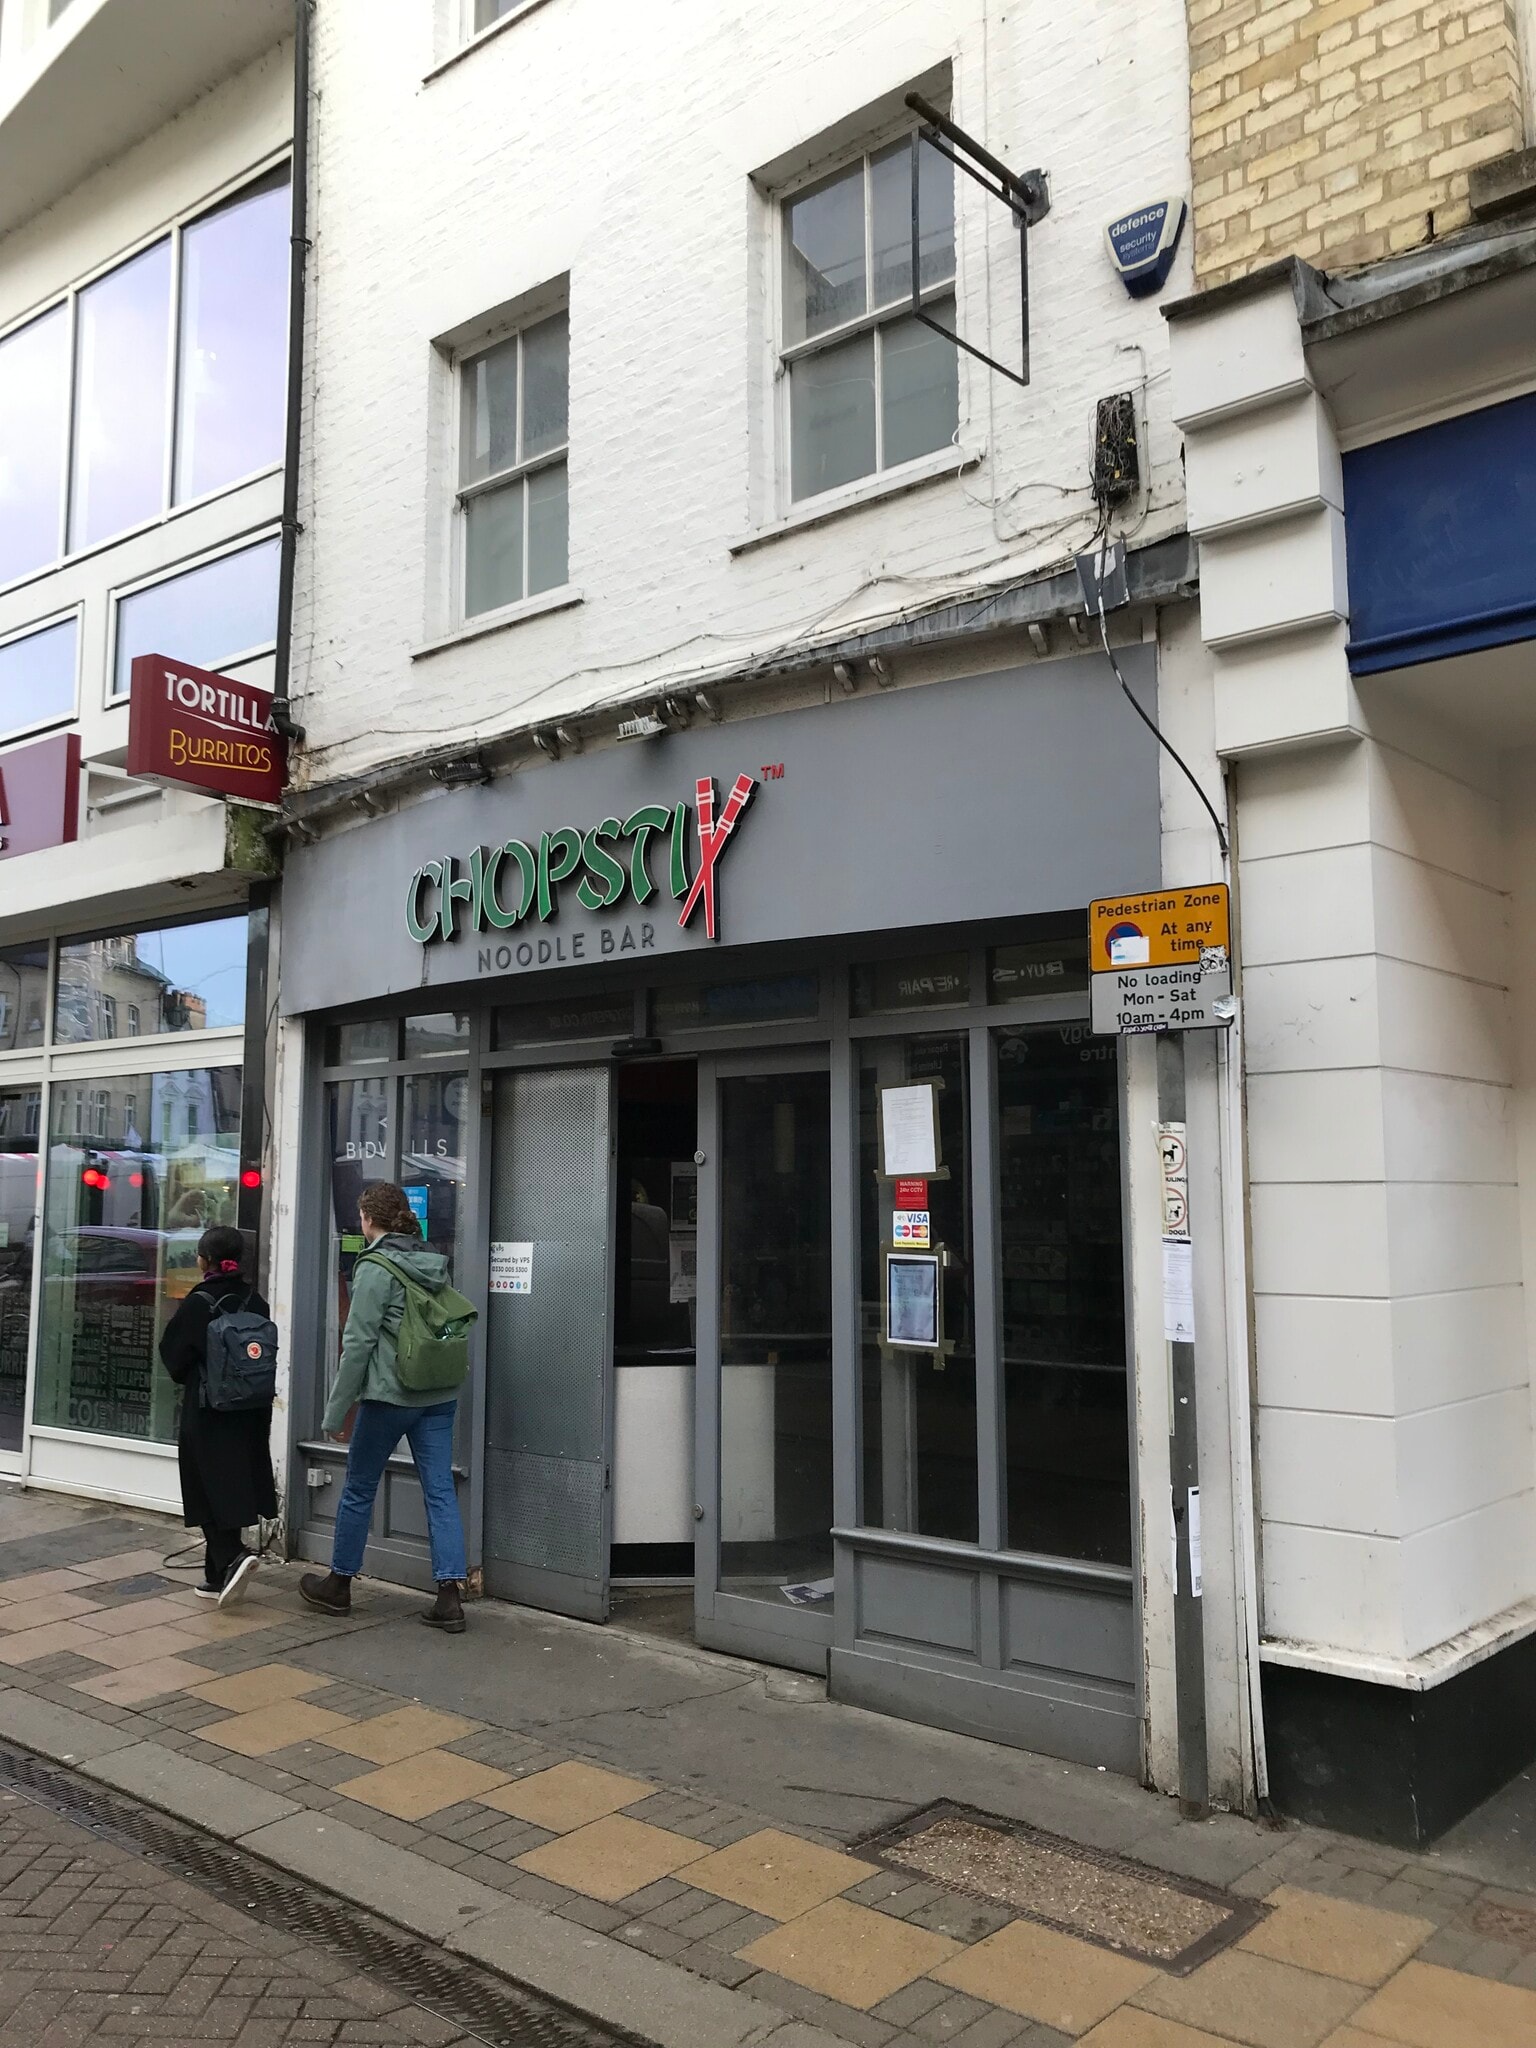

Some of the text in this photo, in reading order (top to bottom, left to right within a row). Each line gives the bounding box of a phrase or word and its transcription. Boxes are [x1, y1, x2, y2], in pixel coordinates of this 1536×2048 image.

[1112, 207, 1164, 237] defence
[1119, 230, 1157, 253] security
[761, 763, 785, 781] TM
[1097, 894, 1221, 918] Pedestrian Zone
[1161, 921, 1213, 935] At any
[478, 922, 656, 973] NOODLE BAR
[1170, 938, 1204, 952] time
[1118, 970, 1202, 989] No loading
[1123, 993, 1154, 1006] Mon
[1170, 989, 1197, 1002] Sat
[1116, 1011, 1155, 1025] 10am
[1169, 1008, 1205, 1023] 4pm
[907, 1213, 928, 1223] VISA
[512, 1256, 518, 1264] by
